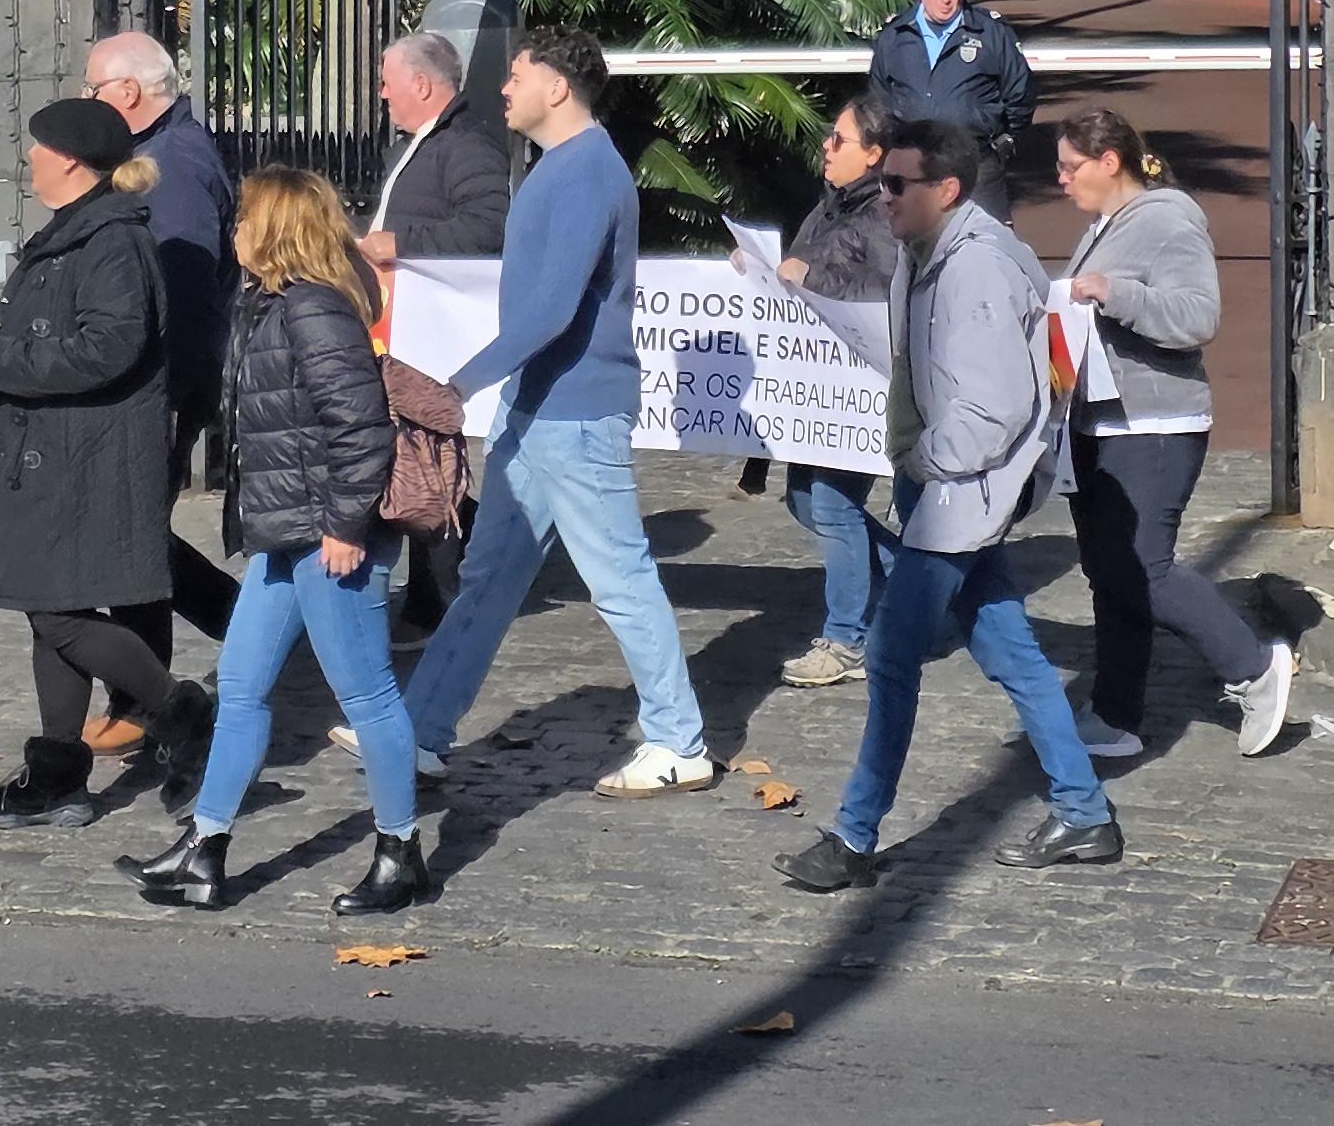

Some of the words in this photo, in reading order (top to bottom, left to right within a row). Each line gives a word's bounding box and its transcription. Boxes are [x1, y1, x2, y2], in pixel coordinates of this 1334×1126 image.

[635, 285, 670, 315] ÃO
[680, 292, 744, 319] DOS
[752, 295, 822, 327] SINDIC
[635, 326, 748, 357] MIGUEL
[756, 332, 770, 359] E
[776, 335, 843, 367] SANTA
[640, 369, 697, 396] ZAR
[706, 373, 742, 400] OS
[751, 376, 887, 417] TRABALHADO
[637, 406, 724, 438] NÇAR
[734, 412, 785, 442] NOS
